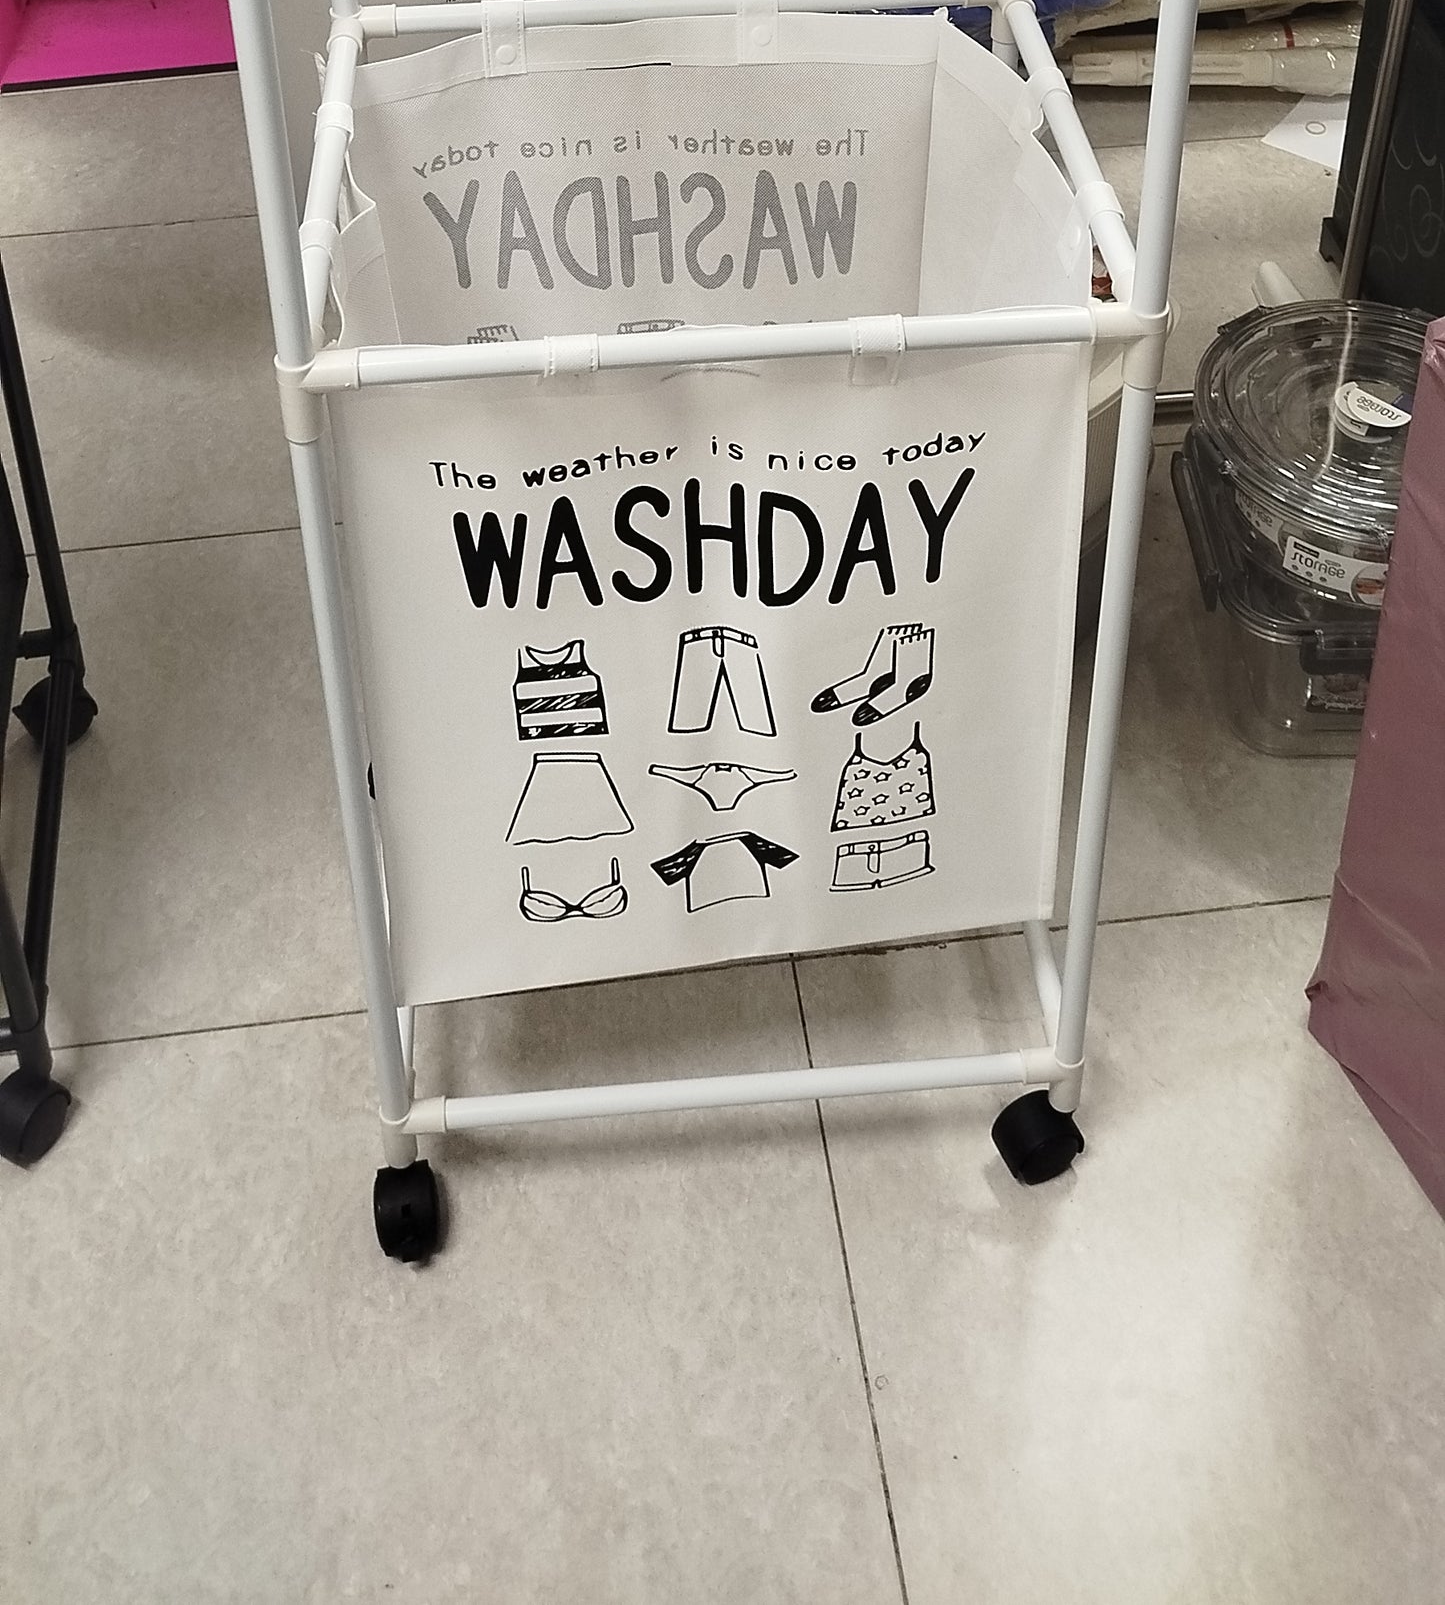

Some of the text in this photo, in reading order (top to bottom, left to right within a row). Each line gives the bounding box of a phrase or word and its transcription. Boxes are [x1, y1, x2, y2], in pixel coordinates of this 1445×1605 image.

[429, 431, 987, 490] The weather is nice today
[452, 467, 976, 610] WASHDAY
